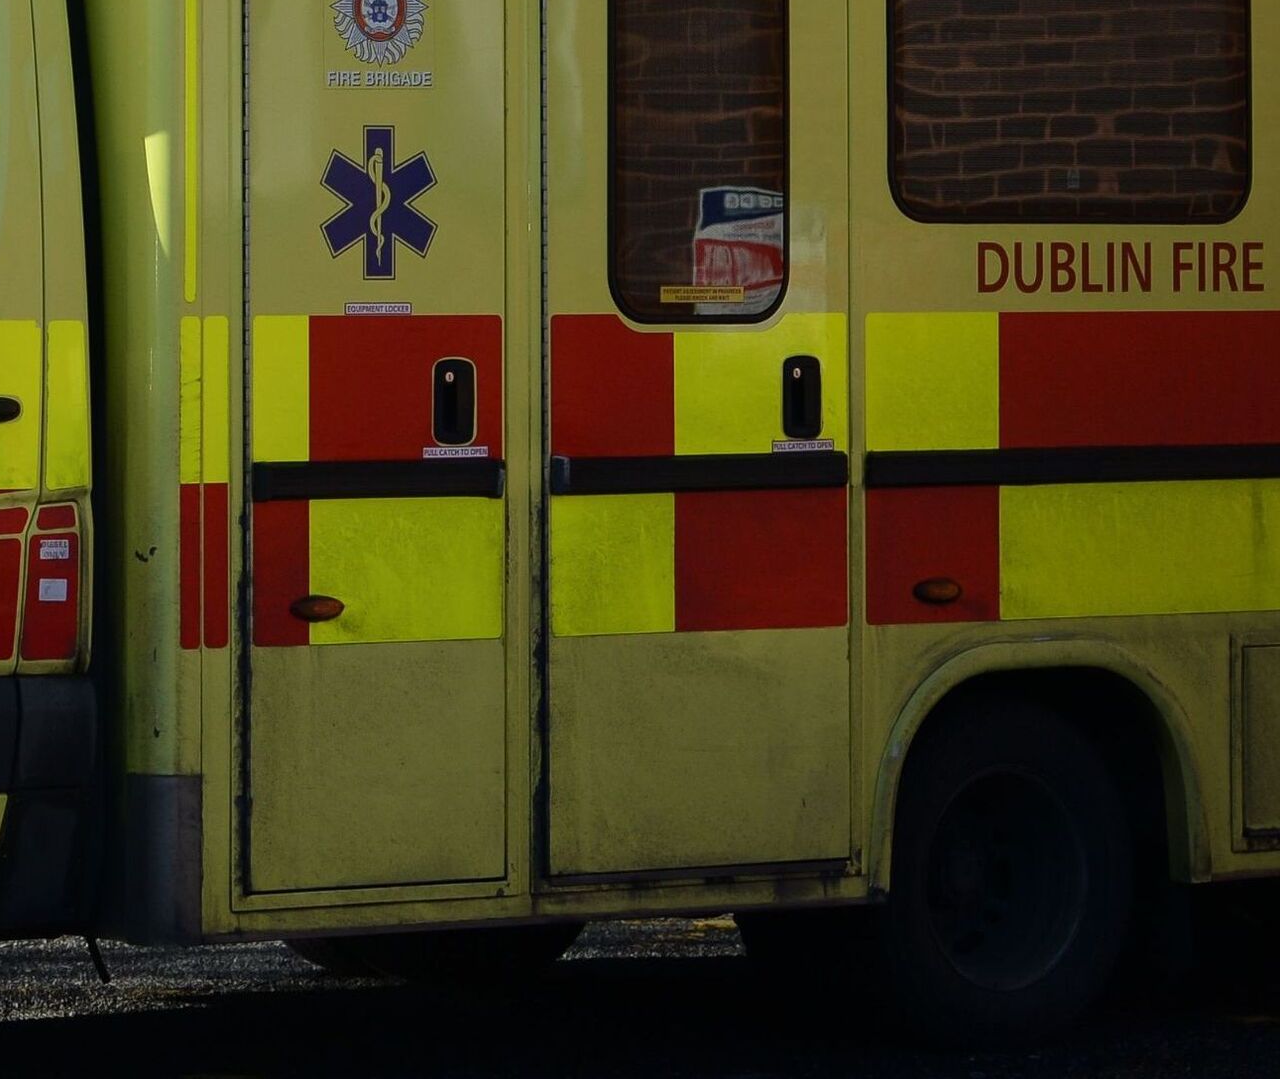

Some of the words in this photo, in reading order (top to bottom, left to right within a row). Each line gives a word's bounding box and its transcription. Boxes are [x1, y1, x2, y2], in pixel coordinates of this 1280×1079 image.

[327, 71, 361, 88] FIRE
[365, 71, 433, 88] BRIGADE
[976, 241, 1152, 294] DUBLIN
[1171, 241, 1266, 293] FIRE
[347, 305, 384, 313] EQUIPMENT
[385, 305, 409, 313] LOCKER
